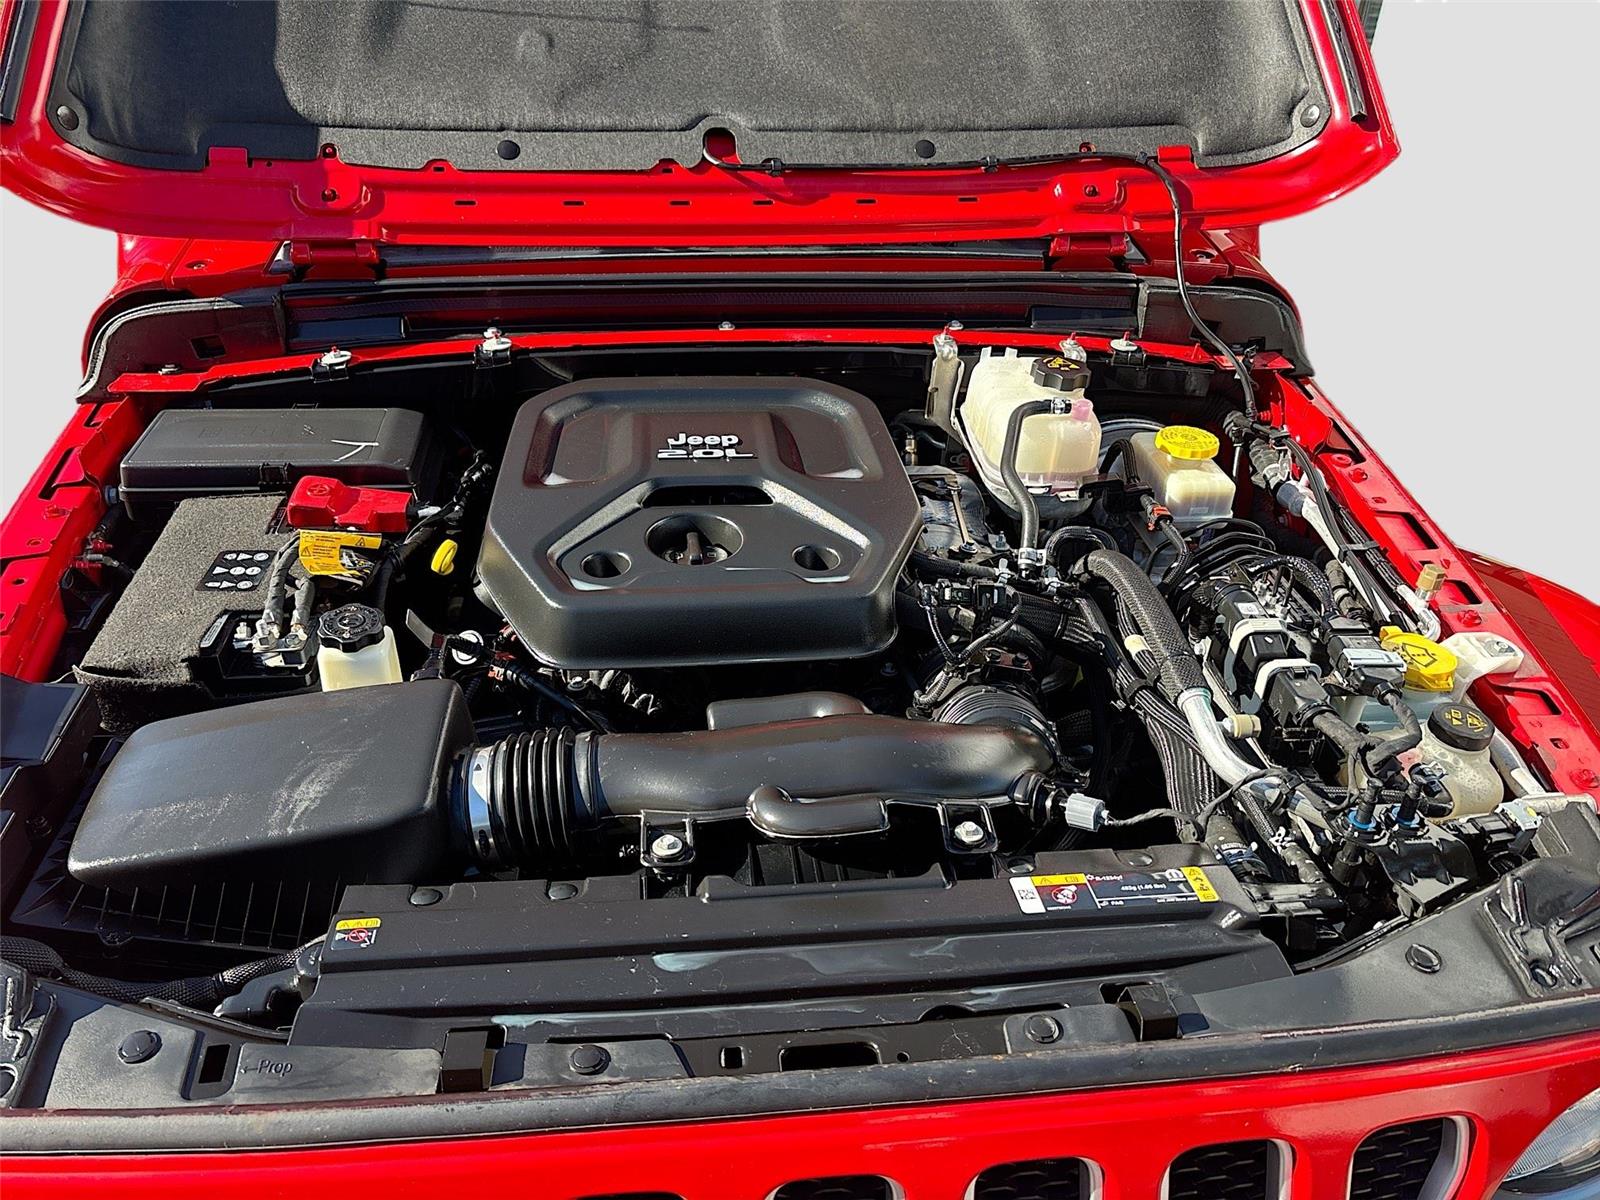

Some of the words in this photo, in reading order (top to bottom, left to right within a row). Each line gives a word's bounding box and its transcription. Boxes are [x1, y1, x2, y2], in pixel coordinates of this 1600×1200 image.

[667, 433, 739, 447] Jeep
[657, 448, 754, 459] 2.0L
[258, 1059, 293, 1077] Prop
